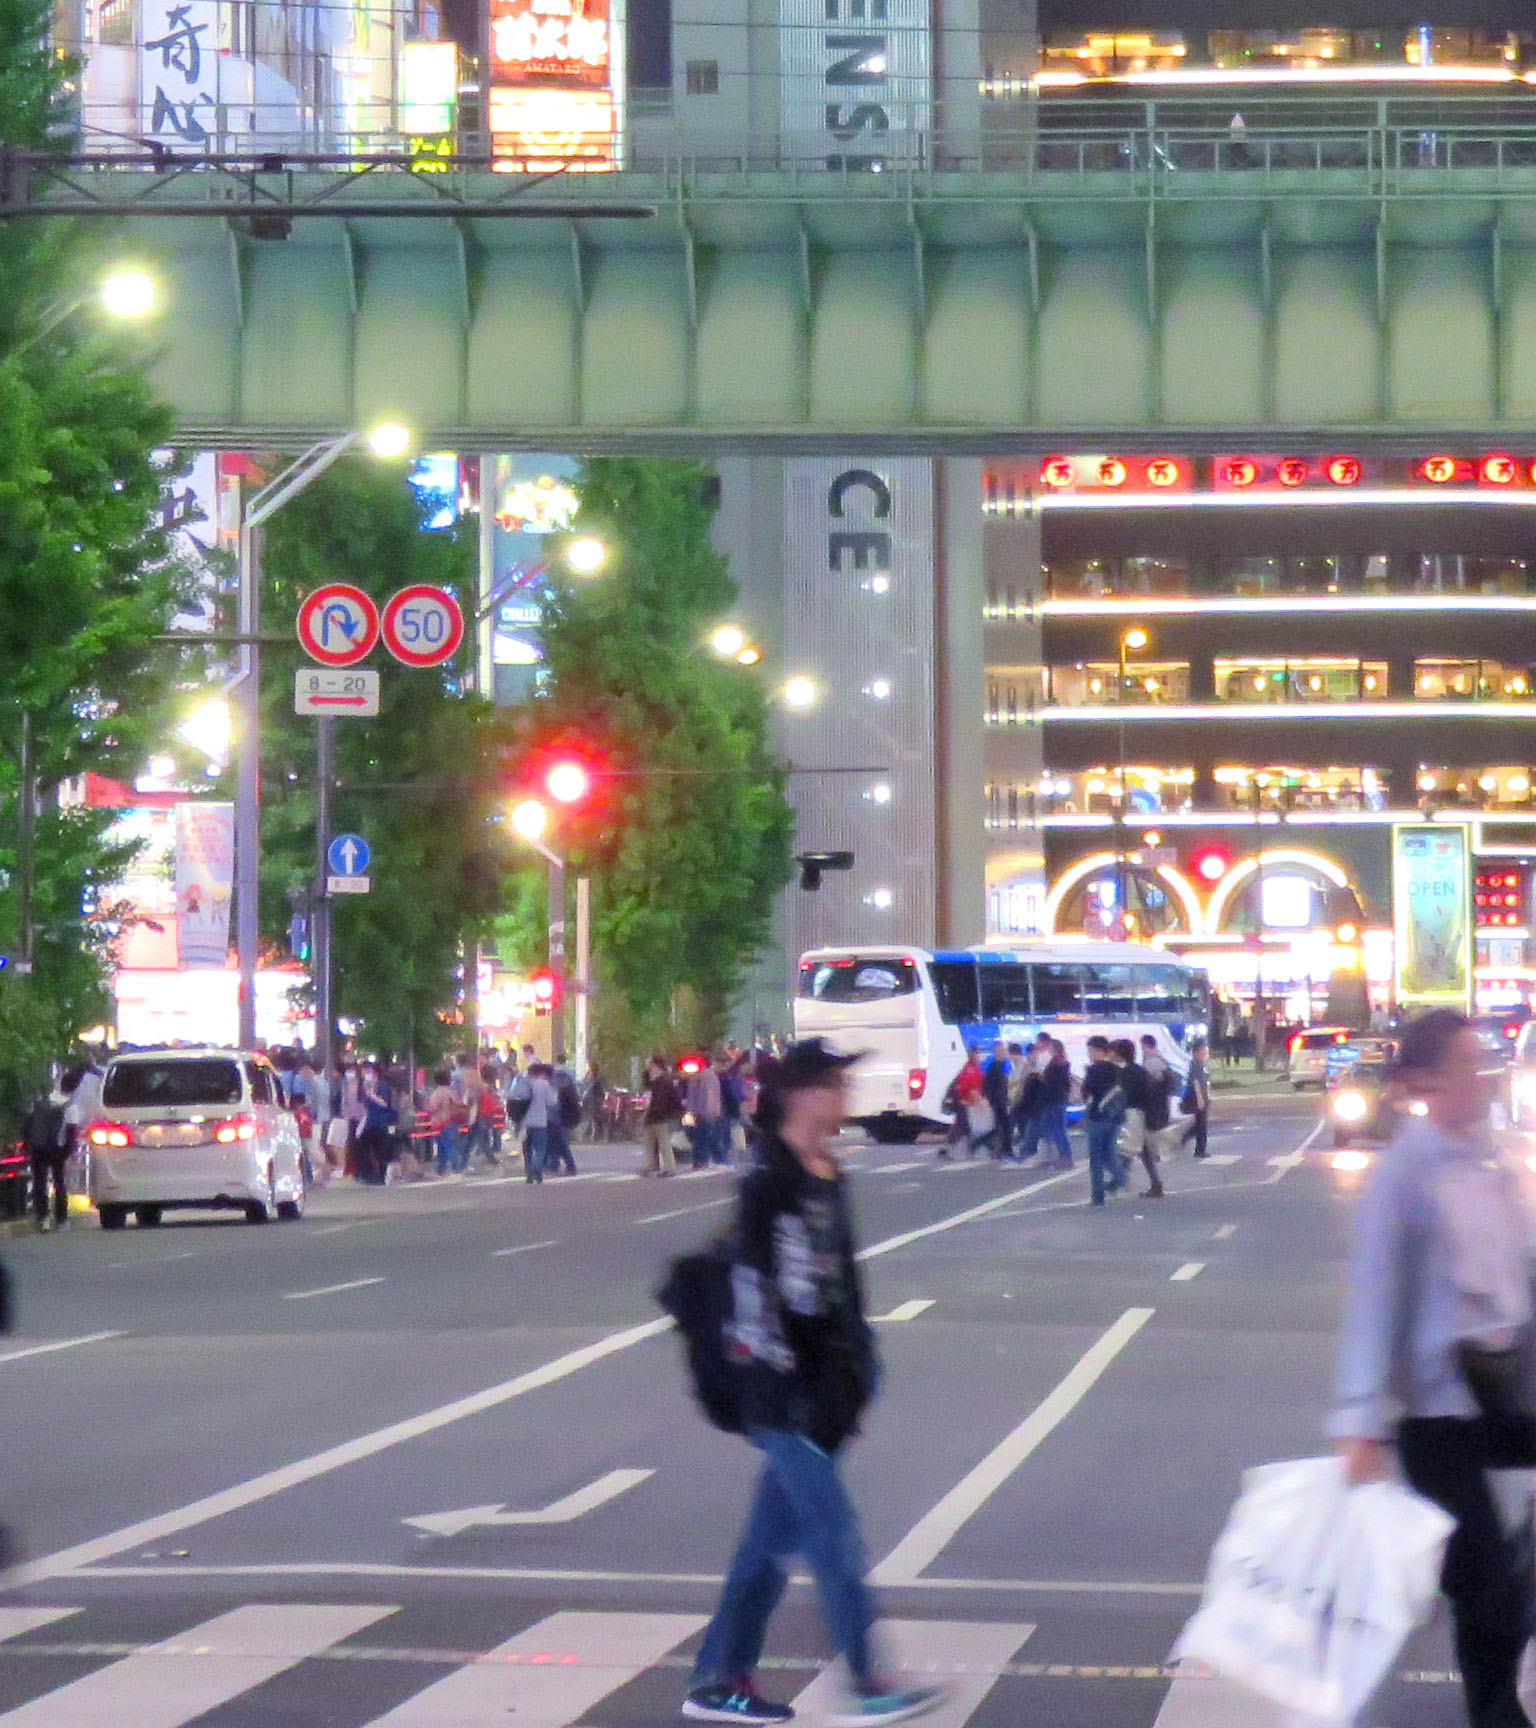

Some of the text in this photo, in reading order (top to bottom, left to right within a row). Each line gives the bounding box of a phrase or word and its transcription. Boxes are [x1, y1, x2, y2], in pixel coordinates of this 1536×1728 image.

[400, 609, 444, 643] 50
[343, 676, 366, 692] 20
[1407, 881, 1456, 897] OPEN
